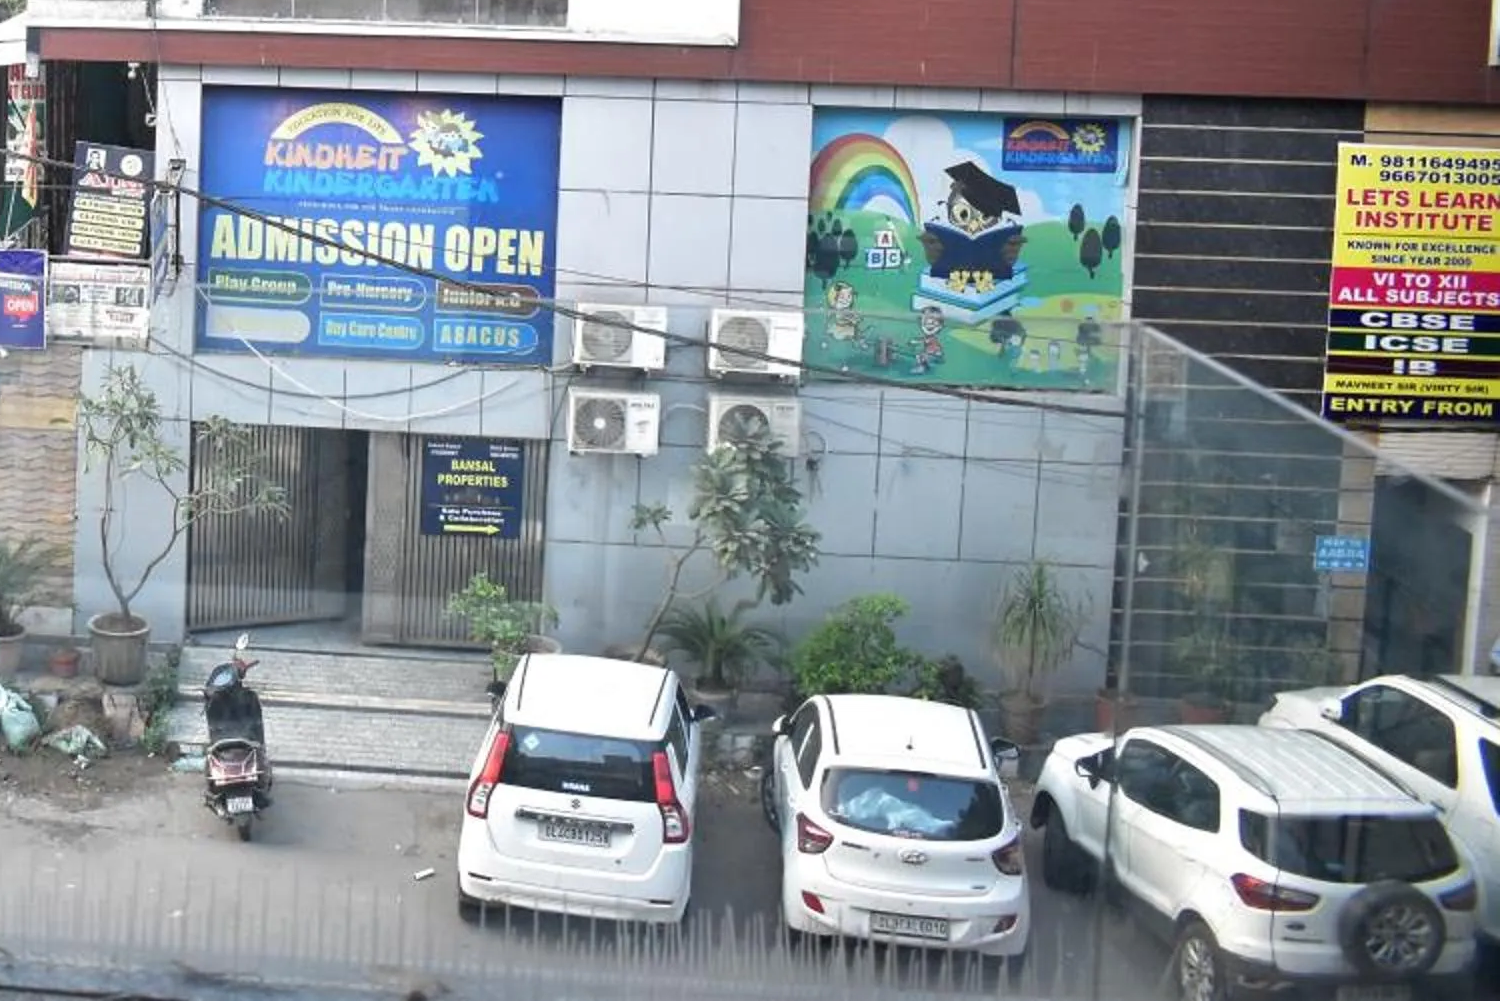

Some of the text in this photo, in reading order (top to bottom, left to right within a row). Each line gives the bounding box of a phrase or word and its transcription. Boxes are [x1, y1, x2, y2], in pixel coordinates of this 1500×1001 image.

[263, 169, 500, 203] KINDERGARTEN
[1347, 188, 1500, 210] LETS LEARN
[1355, 210, 1493, 232] INSTITUTE
[211, 213, 545, 277] ADMISSION OPEN
[880, 233, 890, 245] A
[1347, 240, 1497, 255] KNOWN FOR EXCELLENCE
[871, 253, 898, 265] B C
[1371, 254, 1406, 265] SINCE
[1410, 255, 1441, 266] YEAR
[1372, 272, 1468, 290] VI TO XII
[1338, 286, 1500, 307] ALL SUBJECTS
[1360, 311, 1476, 331] CBSE
[440, 324, 519, 347] ABACUS
[1364, 334, 1470, 354] ICSE
[1393, 358, 1438, 375] IB
[1330, 397, 1493, 417] ENTRY FROM
[451, 459, 496, 472] BANSAL
[437, 473, 509, 488] PROPERTIES
